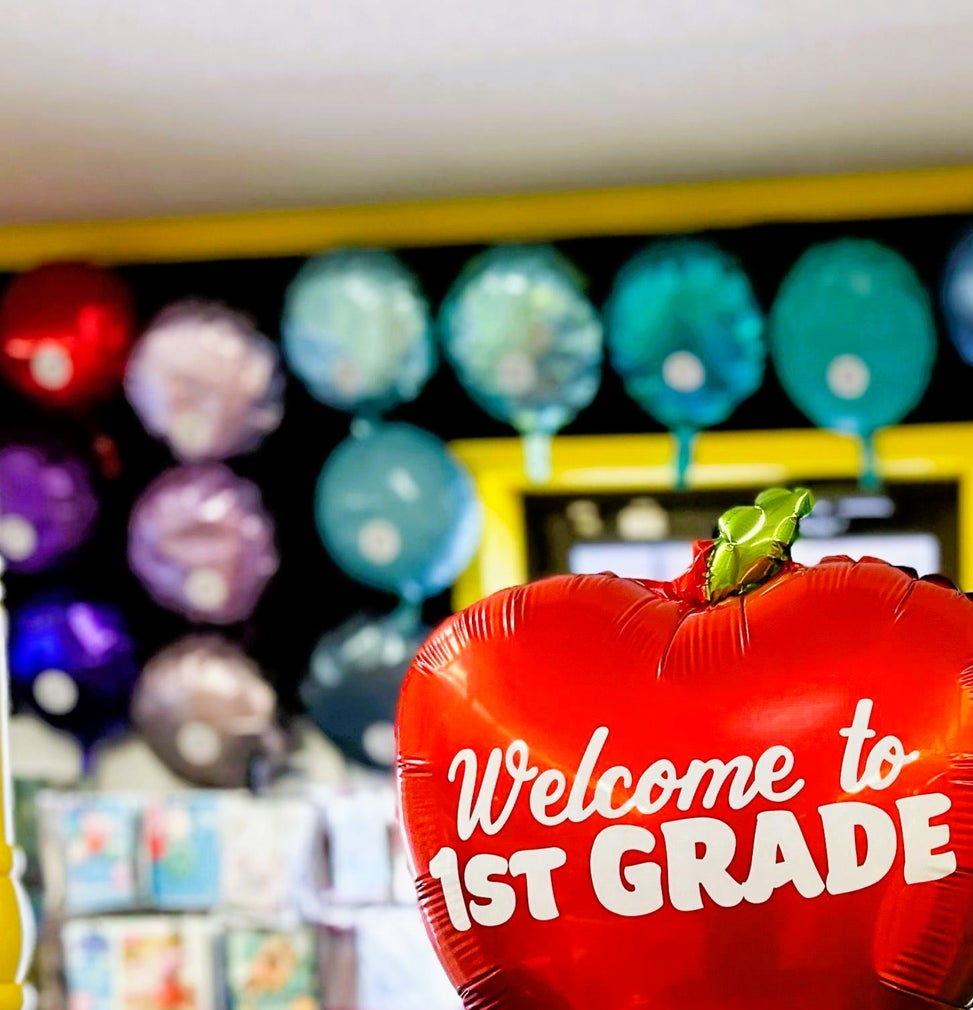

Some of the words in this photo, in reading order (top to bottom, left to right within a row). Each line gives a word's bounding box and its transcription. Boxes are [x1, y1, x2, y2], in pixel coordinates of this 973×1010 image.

[448, 726, 804, 840] Welcome
[839, 698, 919, 793] to
[428, 846, 566, 932] 1ST
[590, 793, 957, 917] GRADE
